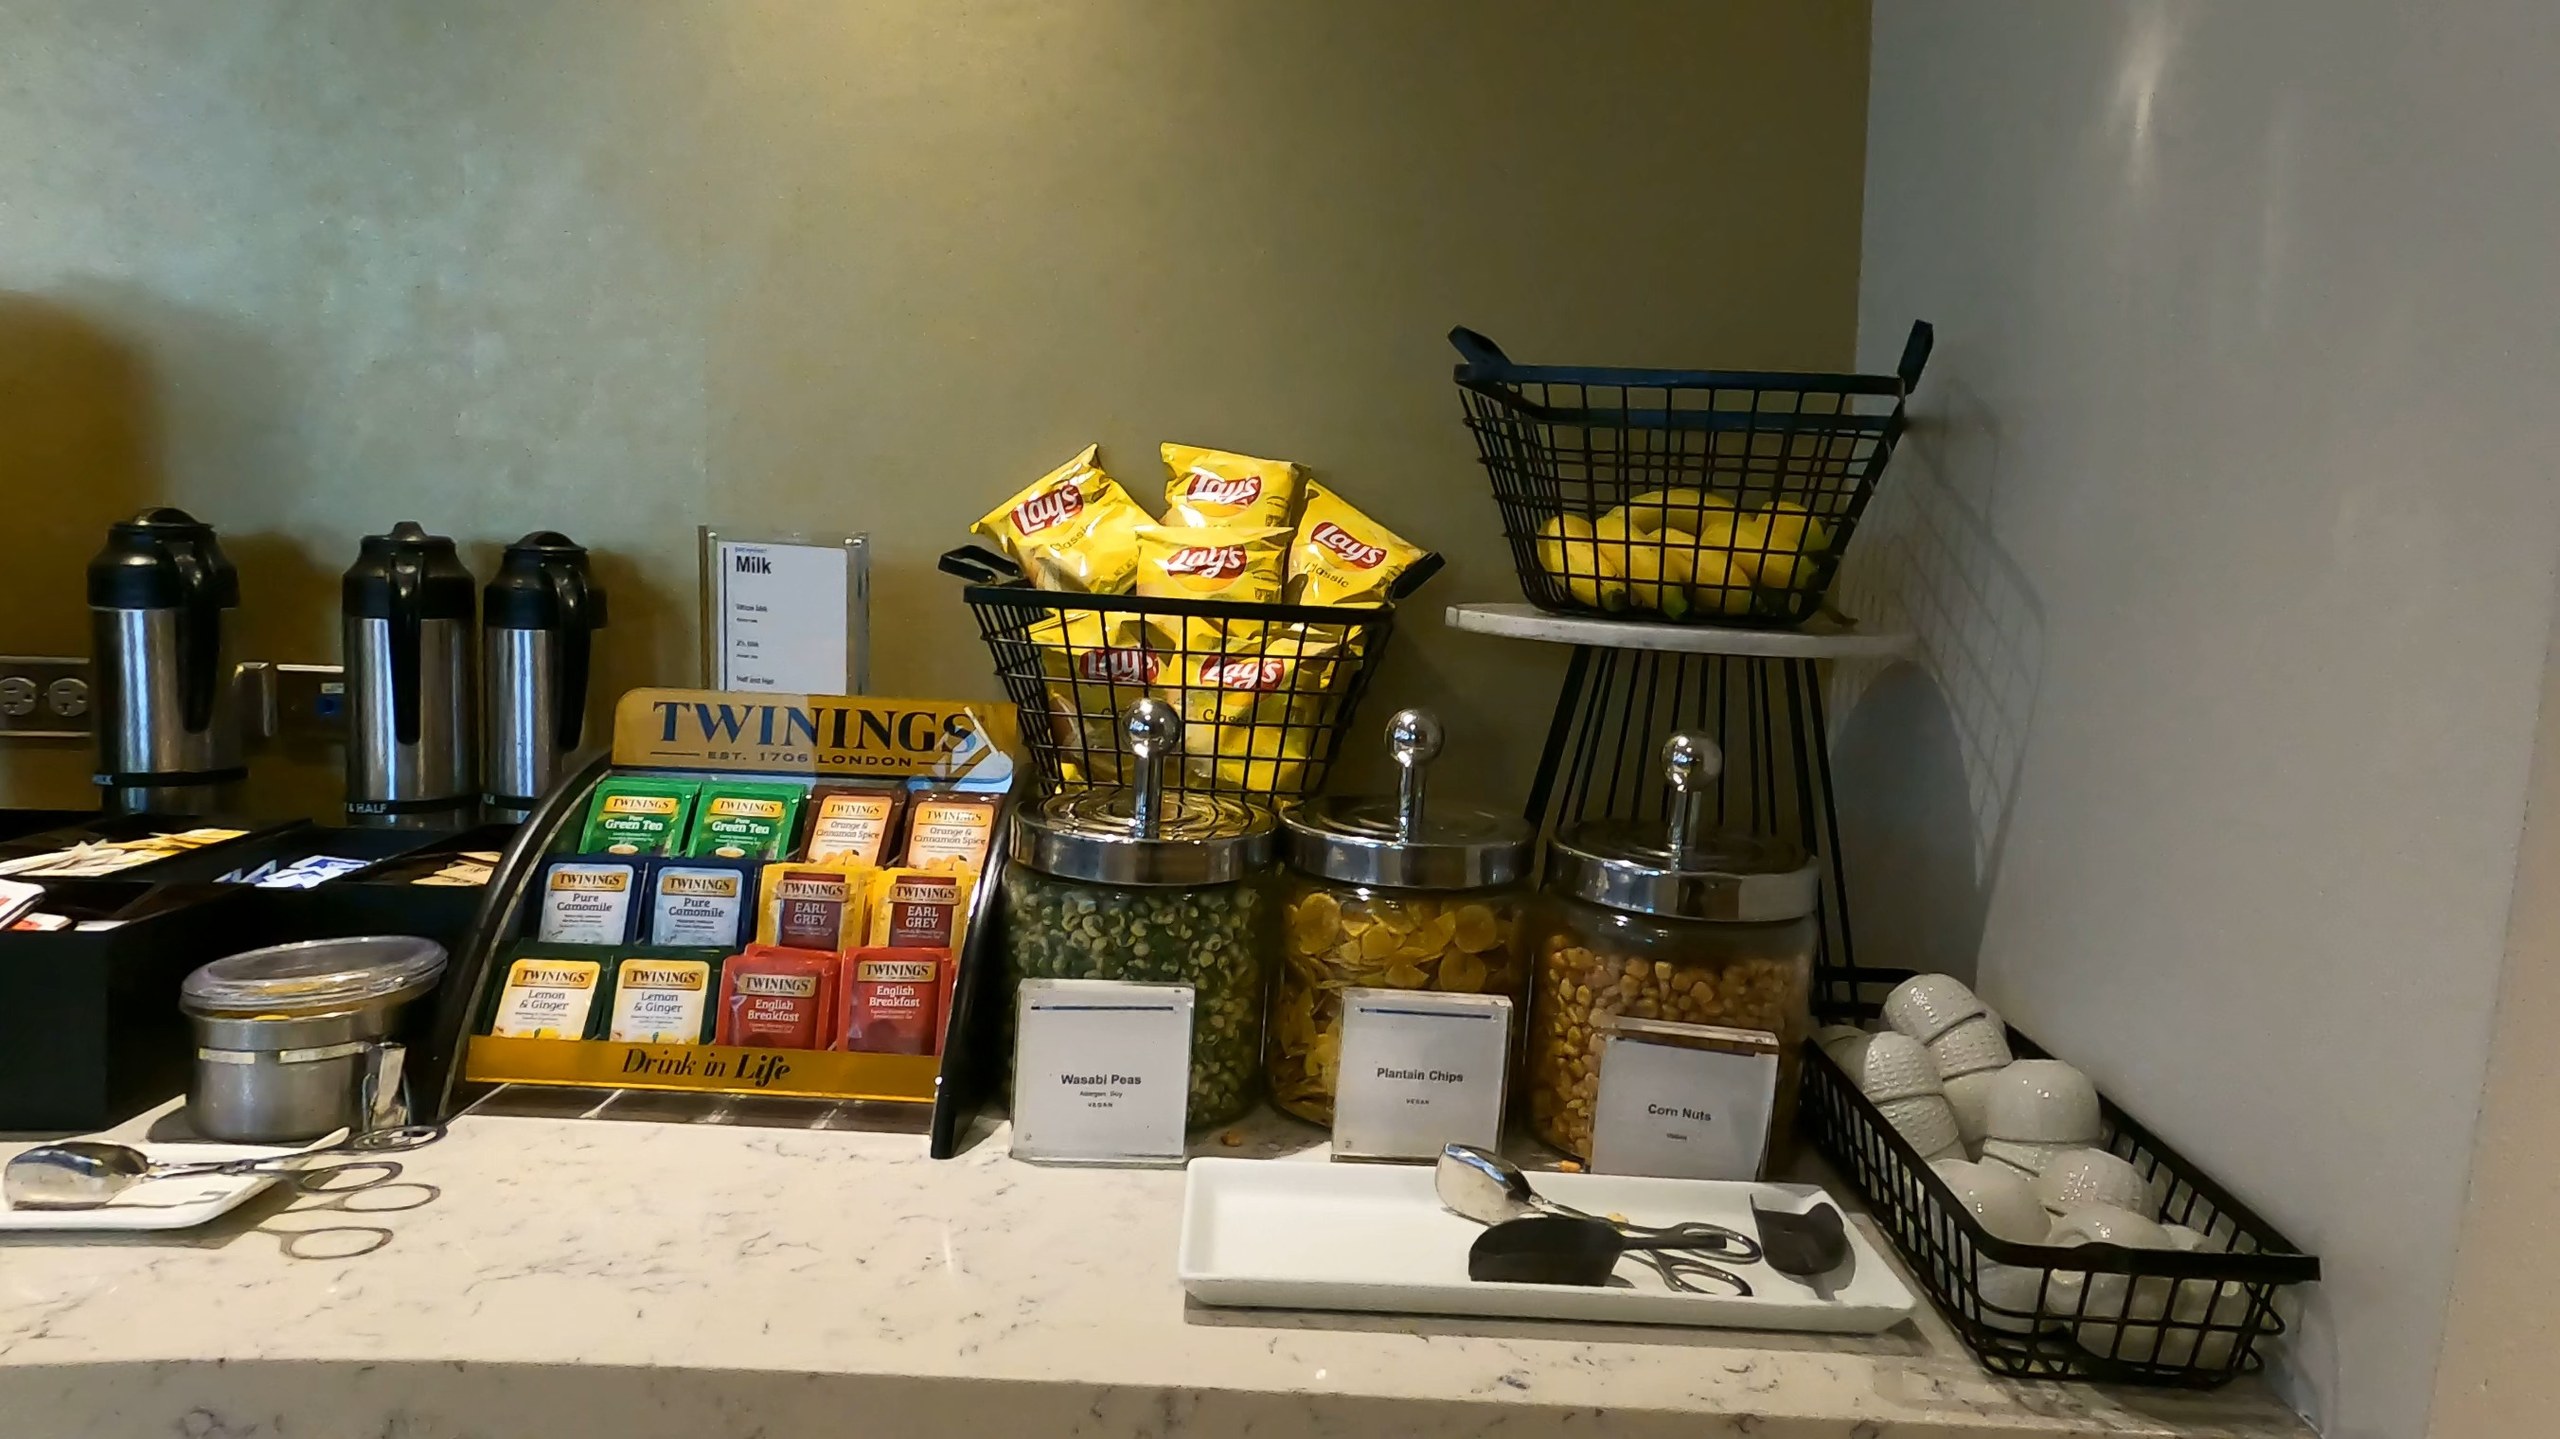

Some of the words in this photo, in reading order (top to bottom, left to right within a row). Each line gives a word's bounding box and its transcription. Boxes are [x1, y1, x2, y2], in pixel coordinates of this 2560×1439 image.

[736, 555, 772, 575] Milk
[1166, 545, 1245, 579] Lay's
[1304, 561, 1349, 588] Classic
[1203, 657, 1282, 690] Lay's
[653, 701, 977, 754] TWININGS
[708, 751, 748, 762] EST.
[759, 752, 809, 763] 1706
[818, 754, 912, 768] LONDON
[355, 803, 388, 814] HALF
[613, 798, 670, 810] TWININGS
[720, 800, 776, 813] TWININGS
[831, 804, 880, 815] TWININGS
[605, 819, 641, 831] Green
[642, 820, 664, 832] Tea
[712, 821, 747, 833] Green
[749, 824, 770, 835] Tea
[830, 821, 862, 831] Orange
[930, 827, 965, 837] Orange
[816, 829, 857, 838] Cinnamon
[858, 830, 881, 840] Spice
[914, 834, 961, 844] Cinnamon
[962, 835, 987, 846] Spice
[560, 873, 620, 886] TWININGS
[670, 878, 730, 890] TWININGS
[783, 884, 844, 896] TWININGS
[897, 887, 956, 900] TWININGS
[573, 893, 599, 903] Pure
[683, 897, 710, 908] Pure
[556, 901, 613, 912] Camomile
[668, 907, 724, 918] Camomile
[795, 903, 827, 914] EARL
[907, 906, 939, 917] EARL
[793, 914, 827, 926] GREY
[905, 917, 939, 929] GREY
[522, 969, 588, 983] TWININGS
[866, 963, 929, 976] TWININGS
[632, 970, 699, 983] TWININGS
[745, 977, 810, 992] TWININGS
[529, 989, 566, 1001] Lemon
[641, 991, 679, 1002] Lemon
[876, 985, 915, 998] English
[519, 1000, 529, 1009] &
[531, 1000, 570, 1013] Ginger
[634, 1002, 642, 1011] &
[645, 1001, 684, 1015] Ginger
[755, 999, 794, 1012] English
[869, 996, 920, 1008] Breakfast
[747, 1010, 800, 1023] Breakfast
[622, 1048, 698, 1076] Drink
[703, 1052, 727, 1077] in
[734, 1054, 792, 1087] Life
[1061, 1074, 1107, 1085] Wasabi
[1110, 1074, 1142, 1086] Peas
[1377, 1067, 1425, 1081] Plantain
[1429, 1071, 1464, 1084] Chips
[1648, 1104, 1678, 1117] Corn
[1682, 1108, 1712, 1122] Nuts
